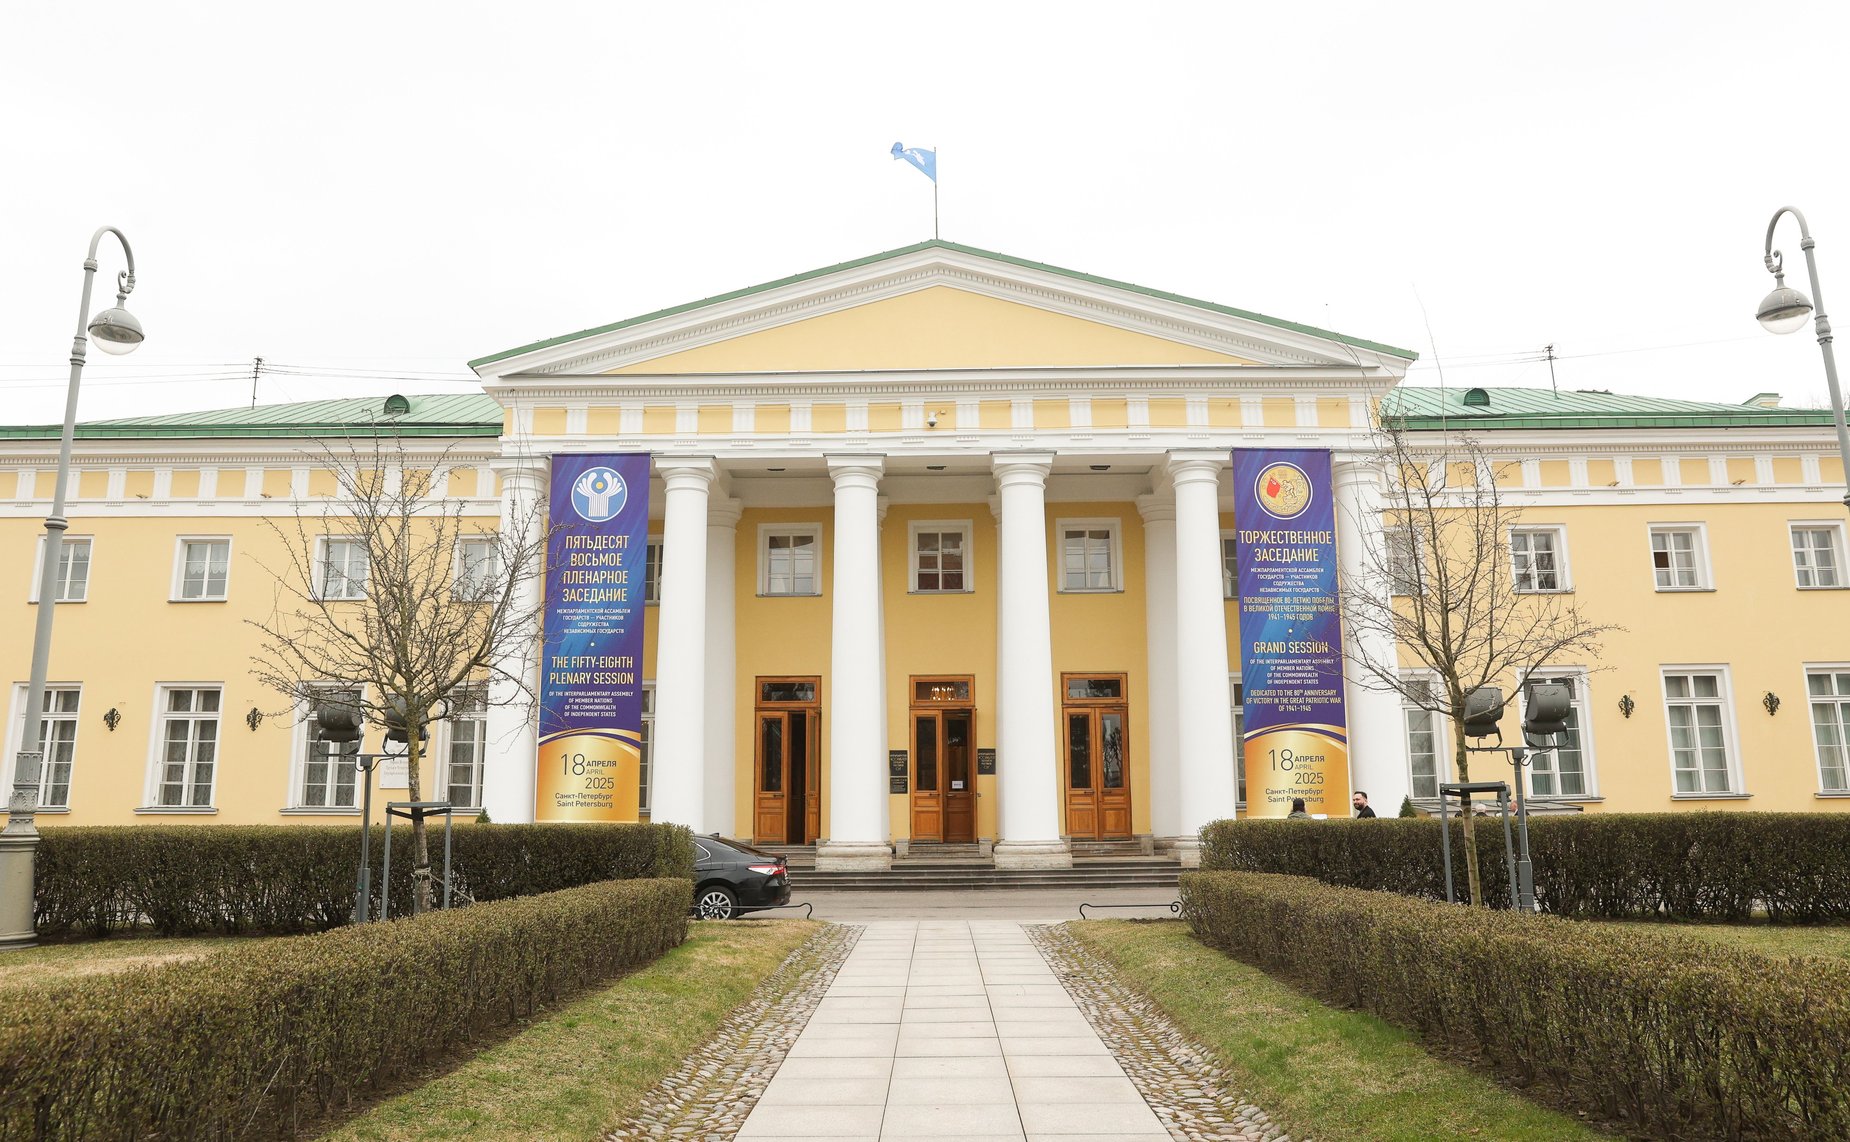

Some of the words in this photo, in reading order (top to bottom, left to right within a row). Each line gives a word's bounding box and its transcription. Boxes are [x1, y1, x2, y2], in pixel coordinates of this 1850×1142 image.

[565, 535, 629, 551] ПЯТЬДЕСЯТ
[1239, 531, 1332, 544] ТОРЖЕСТВЕННОЕ
[570, 553, 622, 567] ВОСЬМОЕ
[1254, 548, 1319, 563] ЗАСЕДАНИЕ
[563, 571, 628, 584] ПЛЕНАРНОЕ
[562, 588, 628, 603] ЗАСЕДАНИЕ
[1249, 604, 1273, 612] ВЕЛИКОЙ
[1254, 642, 1286, 653] GRAND
[1288, 642, 1328, 653] SESSION
[552, 656, 568, 668] THE
[571, 656, 633, 668] FIFTY-EIGHTH
[550, 672, 591, 684] PLENARY
[593, 672, 633, 684] SESSION
[561, 753, 585, 776] 18
[1269, 749, 1293, 771] 18
[585, 777, 614, 789] 2025
[1295, 773, 1323, 784] 2025
[555, 792, 613, 800] Санкт-Петербург
